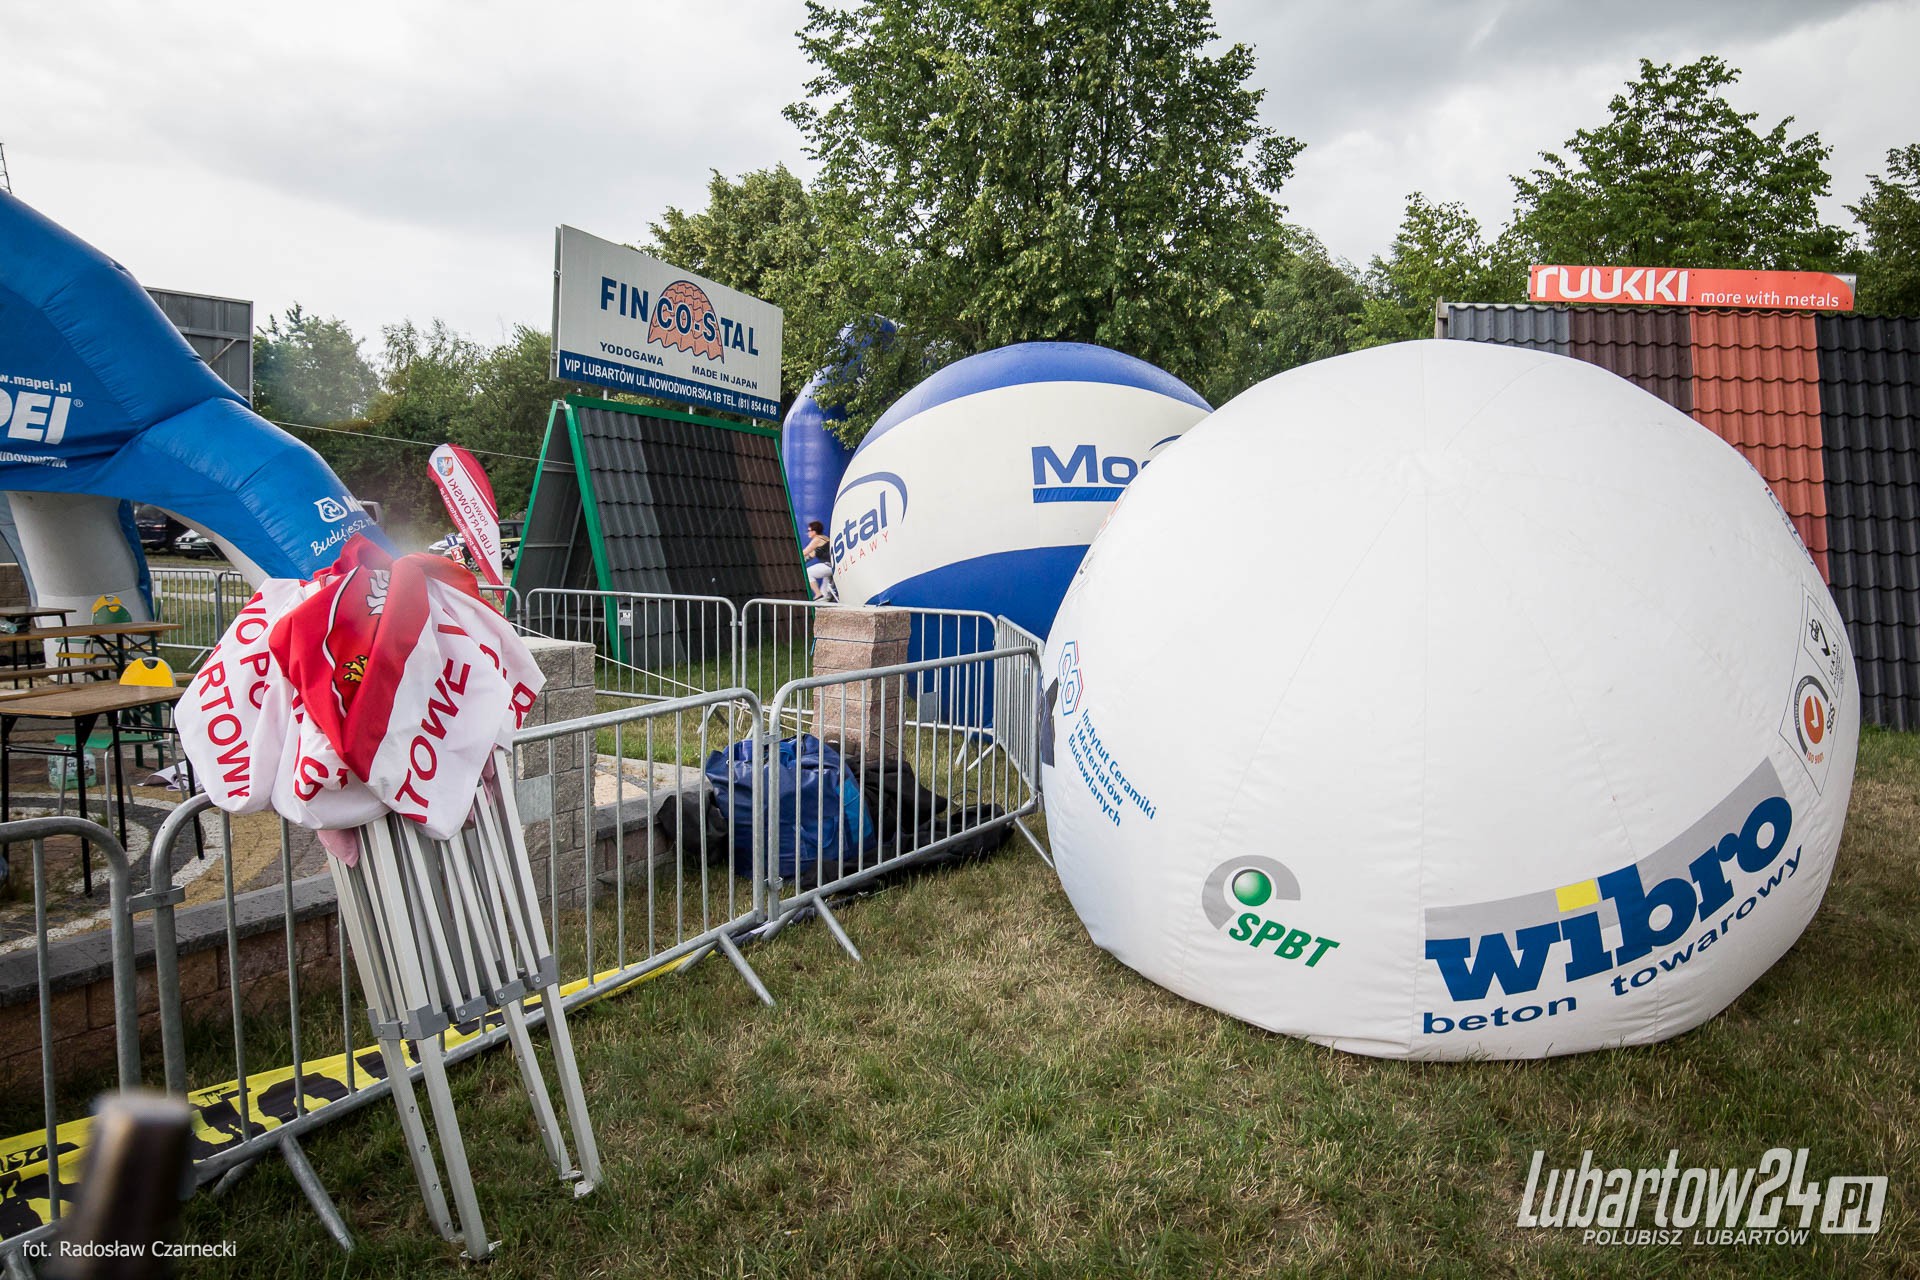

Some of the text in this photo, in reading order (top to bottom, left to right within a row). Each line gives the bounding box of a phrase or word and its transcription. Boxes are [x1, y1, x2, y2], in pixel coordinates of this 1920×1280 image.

[1701, 289, 1839, 308] more with metals
[600, 341, 664, 366] YODOGAWA
[692, 365, 758, 390] MADE IN JAPAN
[564, 358, 581, 374] VIP
[582, 362, 635, 385] LUBARTÓW
[713, 389, 722, 402] 1B
[738, 397, 750, 411] (81)
[750, 400, 762, 412] 854
[762, 402, 769, 414] 41
[1031, 444, 1151, 486] Mo
[1068, 732, 1121, 828] Budowlanych
[1078, 729, 1124, 807] Materiałów
[1081, 708, 1157, 820] Instytut Ceramiki
[1425, 796, 1793, 1003] wibro
[1229, 911, 1341, 968] SPBT
[1423, 843, 1803, 1034] beton towarowy
